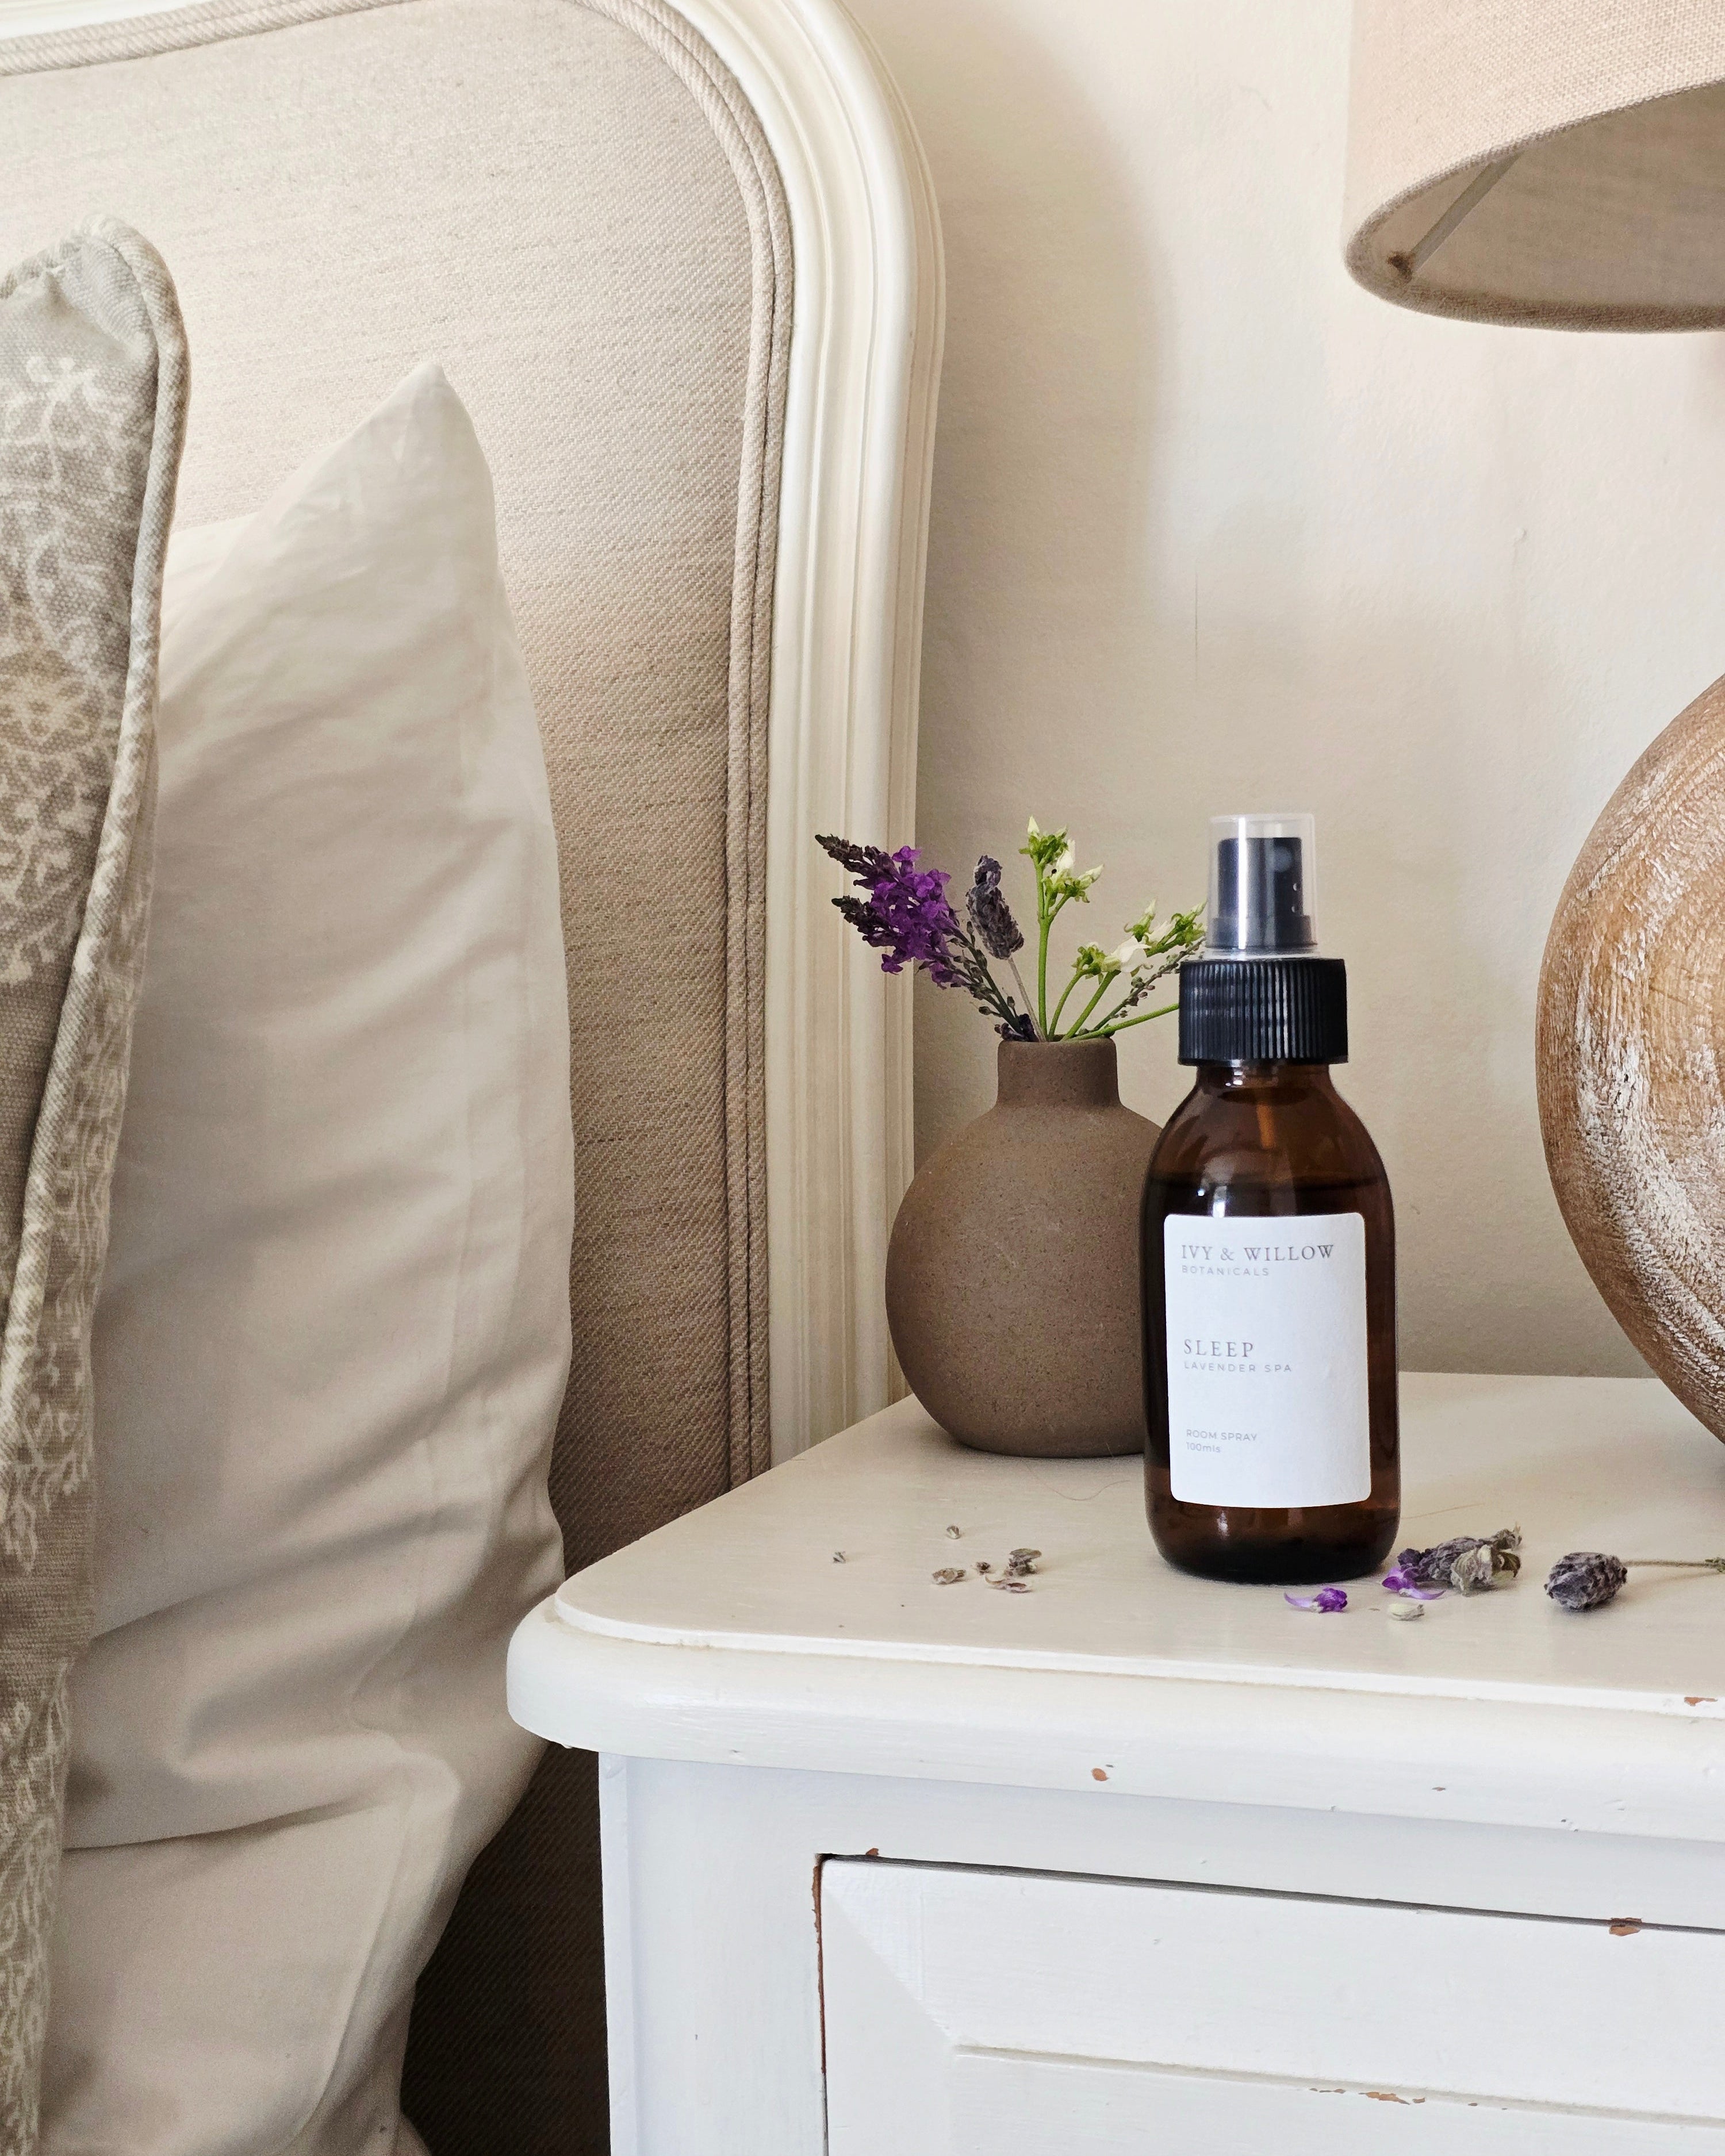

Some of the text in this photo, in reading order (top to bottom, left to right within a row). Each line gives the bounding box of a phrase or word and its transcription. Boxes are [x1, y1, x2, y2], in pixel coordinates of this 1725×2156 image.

[1182, 1244, 1334, 1261] IVY & WILLOW
[1182, 1265, 1270, 1276] BOTANICALS
[1183, 1339, 1254, 1357] SLEEP
[1184, 1361, 1293, 1373] LAVENDER SPA
[1186, 1429, 1258, 1441] ROOM SPRAY
[1186, 1442, 1221, 1453] 100mls
